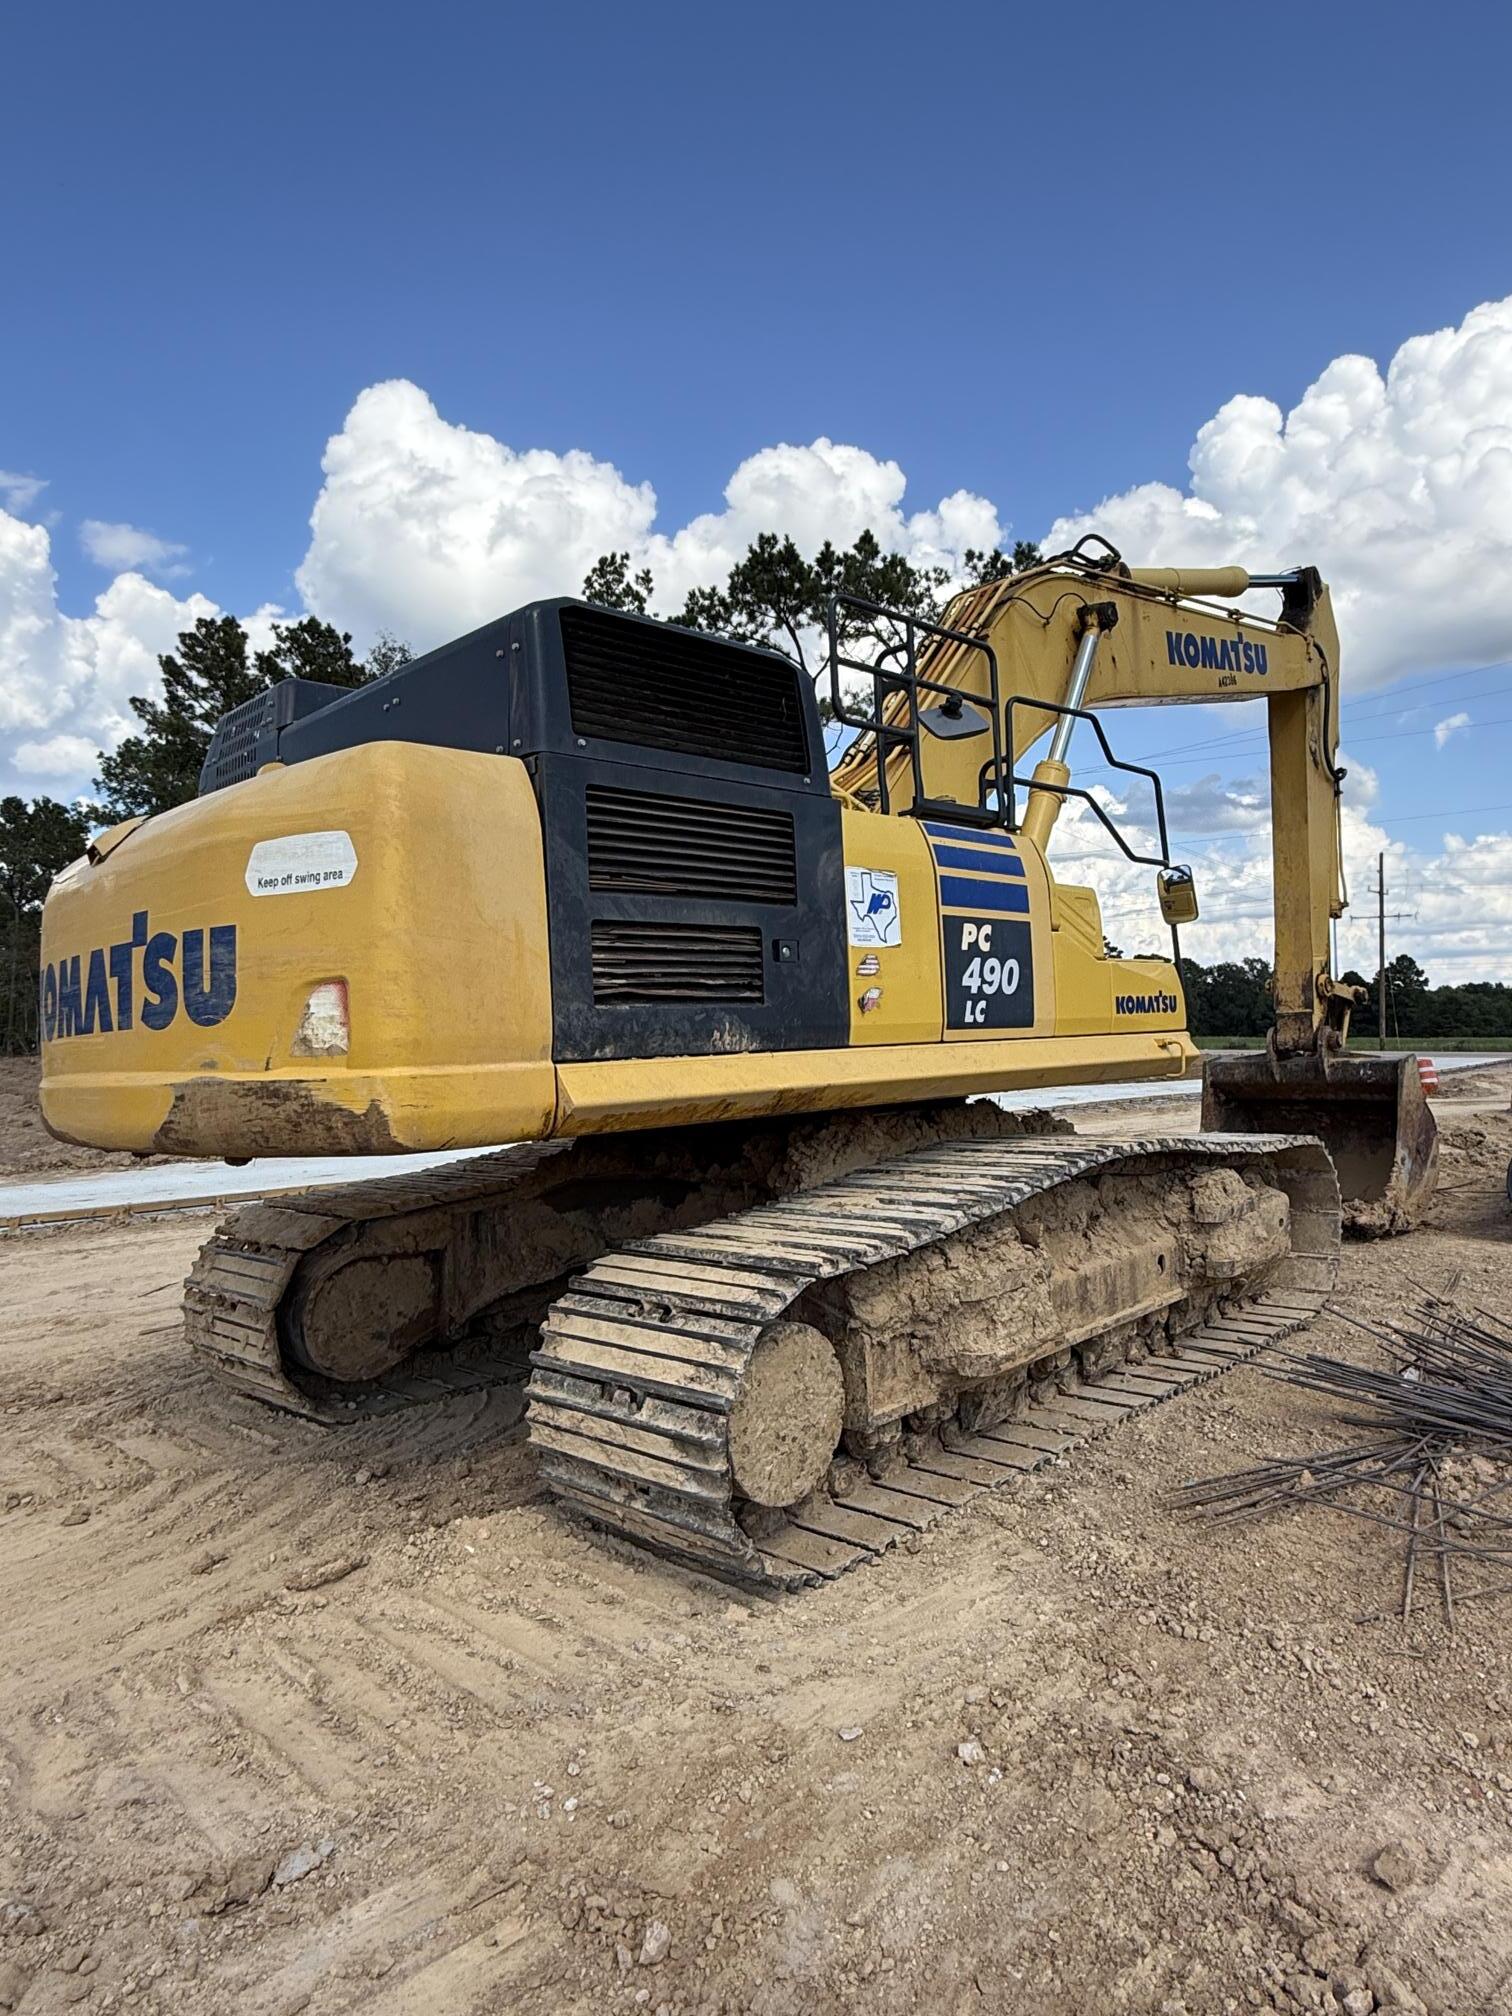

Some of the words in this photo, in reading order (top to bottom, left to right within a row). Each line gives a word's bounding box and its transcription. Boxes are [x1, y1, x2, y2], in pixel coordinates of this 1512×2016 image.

[1166, 631, 1268, 675] KOMATSU
[257, 877, 279, 889] Keep
[281, 873, 292, 886] off
[295, 872, 320, 884] swing
[323, 870, 343, 881] area
[961, 923, 992, 952] PC
[961, 957, 1020, 995] 490
[964, 1000, 987, 1023] LC
[1115, 990, 1177, 1014] KOMATSU
